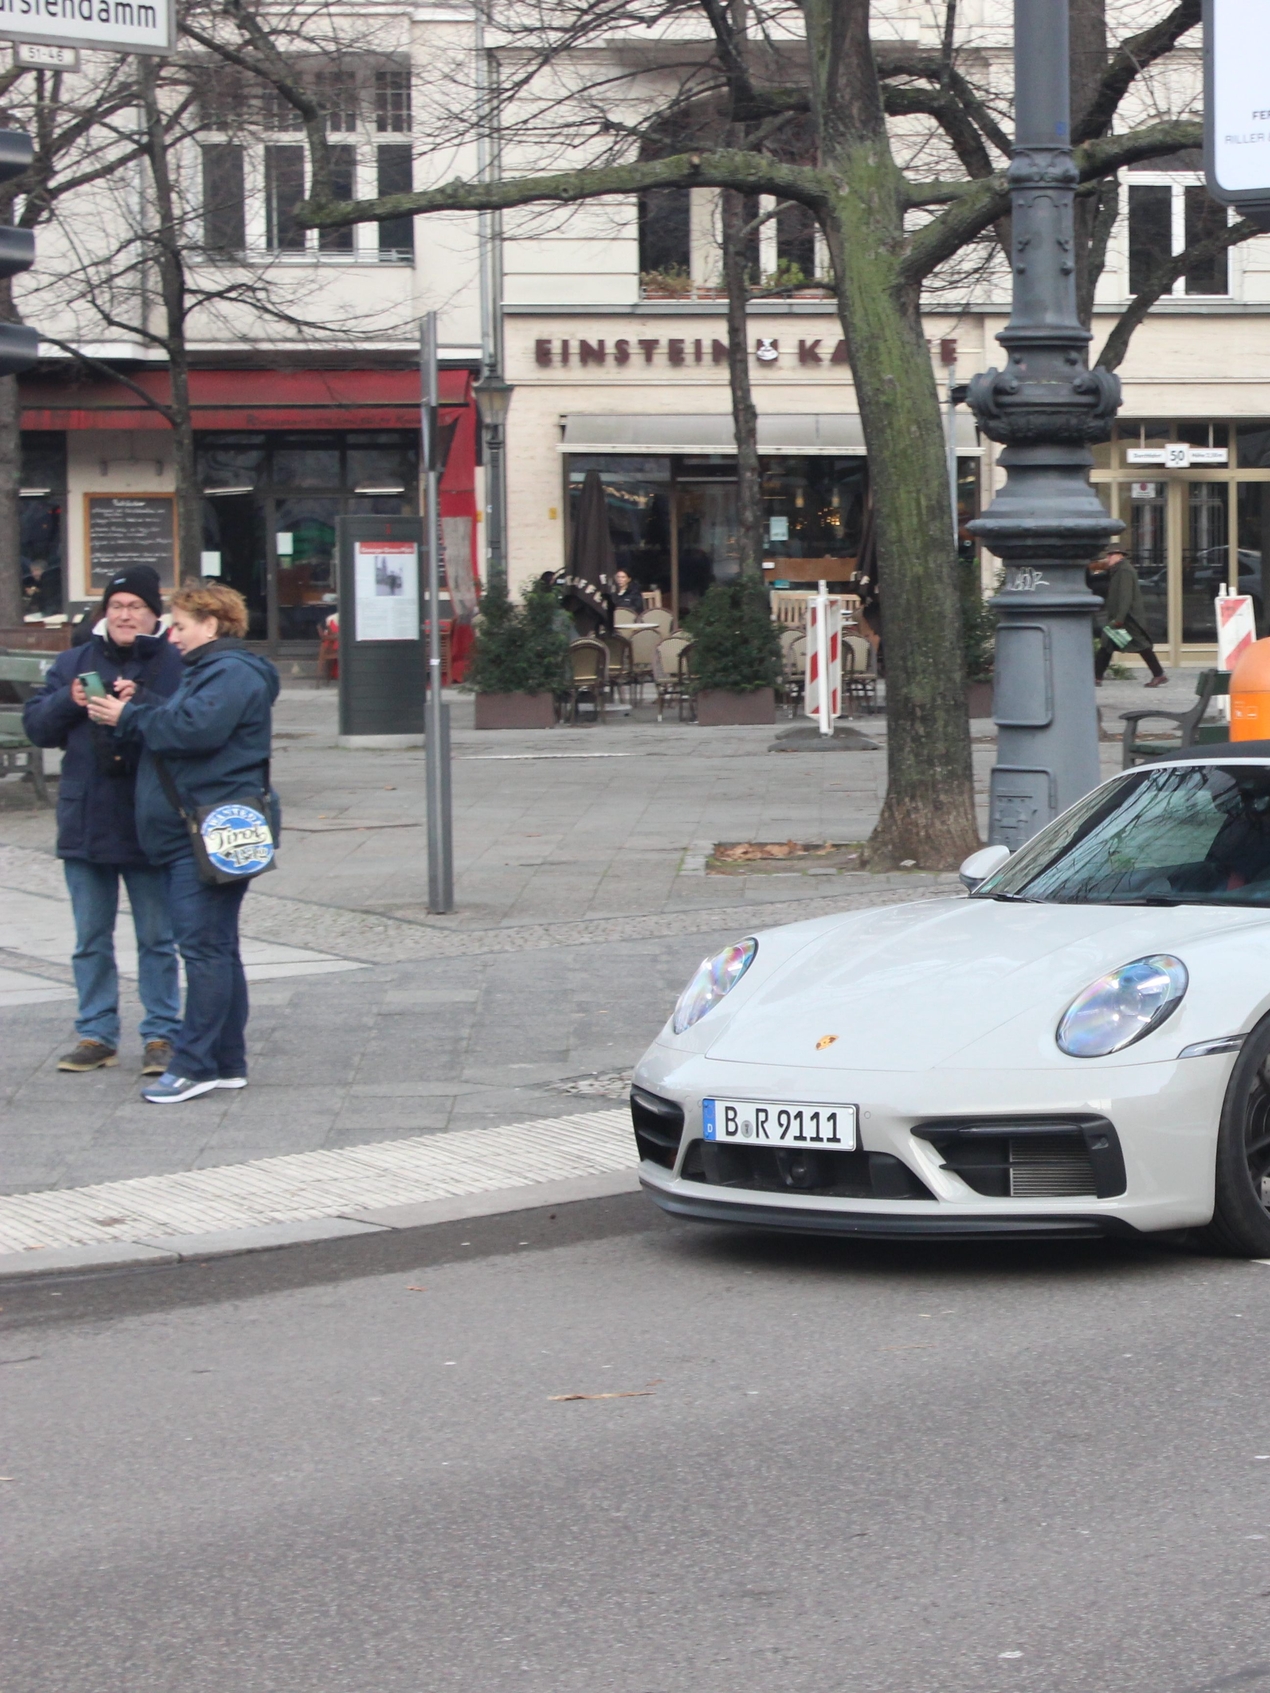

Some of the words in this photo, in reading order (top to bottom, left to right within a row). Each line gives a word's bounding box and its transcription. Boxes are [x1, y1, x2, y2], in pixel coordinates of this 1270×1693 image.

[28, 47, 65, 62] 51-46
[535, 339, 730, 366] EINSTEIN
[1169, 450, 1185, 462] 50
[208, 824, 268, 850] Tirol
[707, 1123, 713, 1133] D
[725, 1106, 739, 1137] B
[755, 1108, 770, 1139] R
[777, 1109, 841, 1144] 9111
